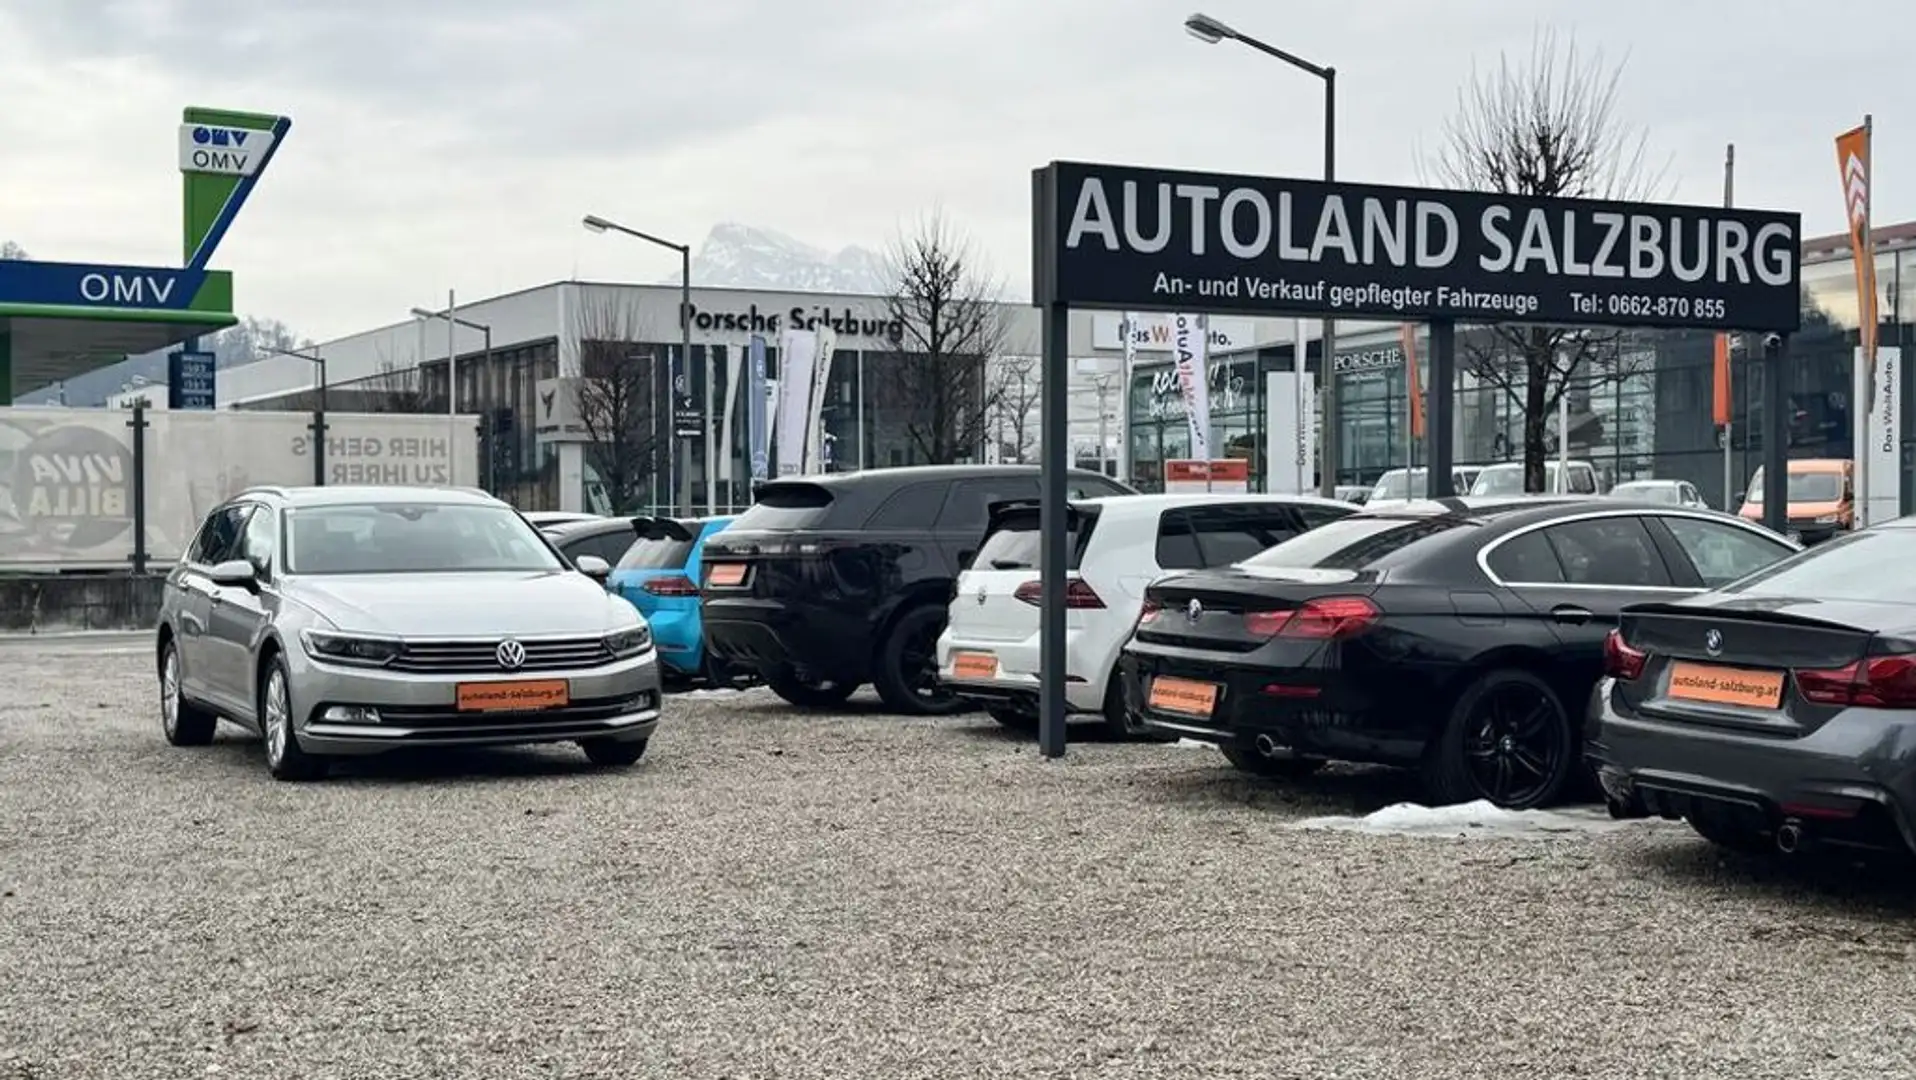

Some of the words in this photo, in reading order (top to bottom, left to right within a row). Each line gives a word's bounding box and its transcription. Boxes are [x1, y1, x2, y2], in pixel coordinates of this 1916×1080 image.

[193, 149, 247, 171] OMV
[1065, 177, 1459, 269] AUTOLAND
[1479, 204, 1793, 286] SALZBURG
[80, 273, 175, 303] OMV
[1153, 271, 1192, 294] An-
[1199, 276, 1239, 297] und
[1245, 276, 1326, 299] Verkauf
[1330, 282, 1432, 310] gepflegter
[1437, 286, 1539, 316] Fahrzeuge
[1570, 292, 1603, 314] Tel:
[1608, 294, 1690, 318] 0662-870
[1694, 299, 1726, 319] 855
[680, 303, 781, 332] Porsche
[789, 306, 904, 344] Salzburg
[1334, 347, 1401, 370] PORSCHE
[1883, 428, 1893, 452] Das
[1672, 675, 1779, 698] autoland-salzburg.at
